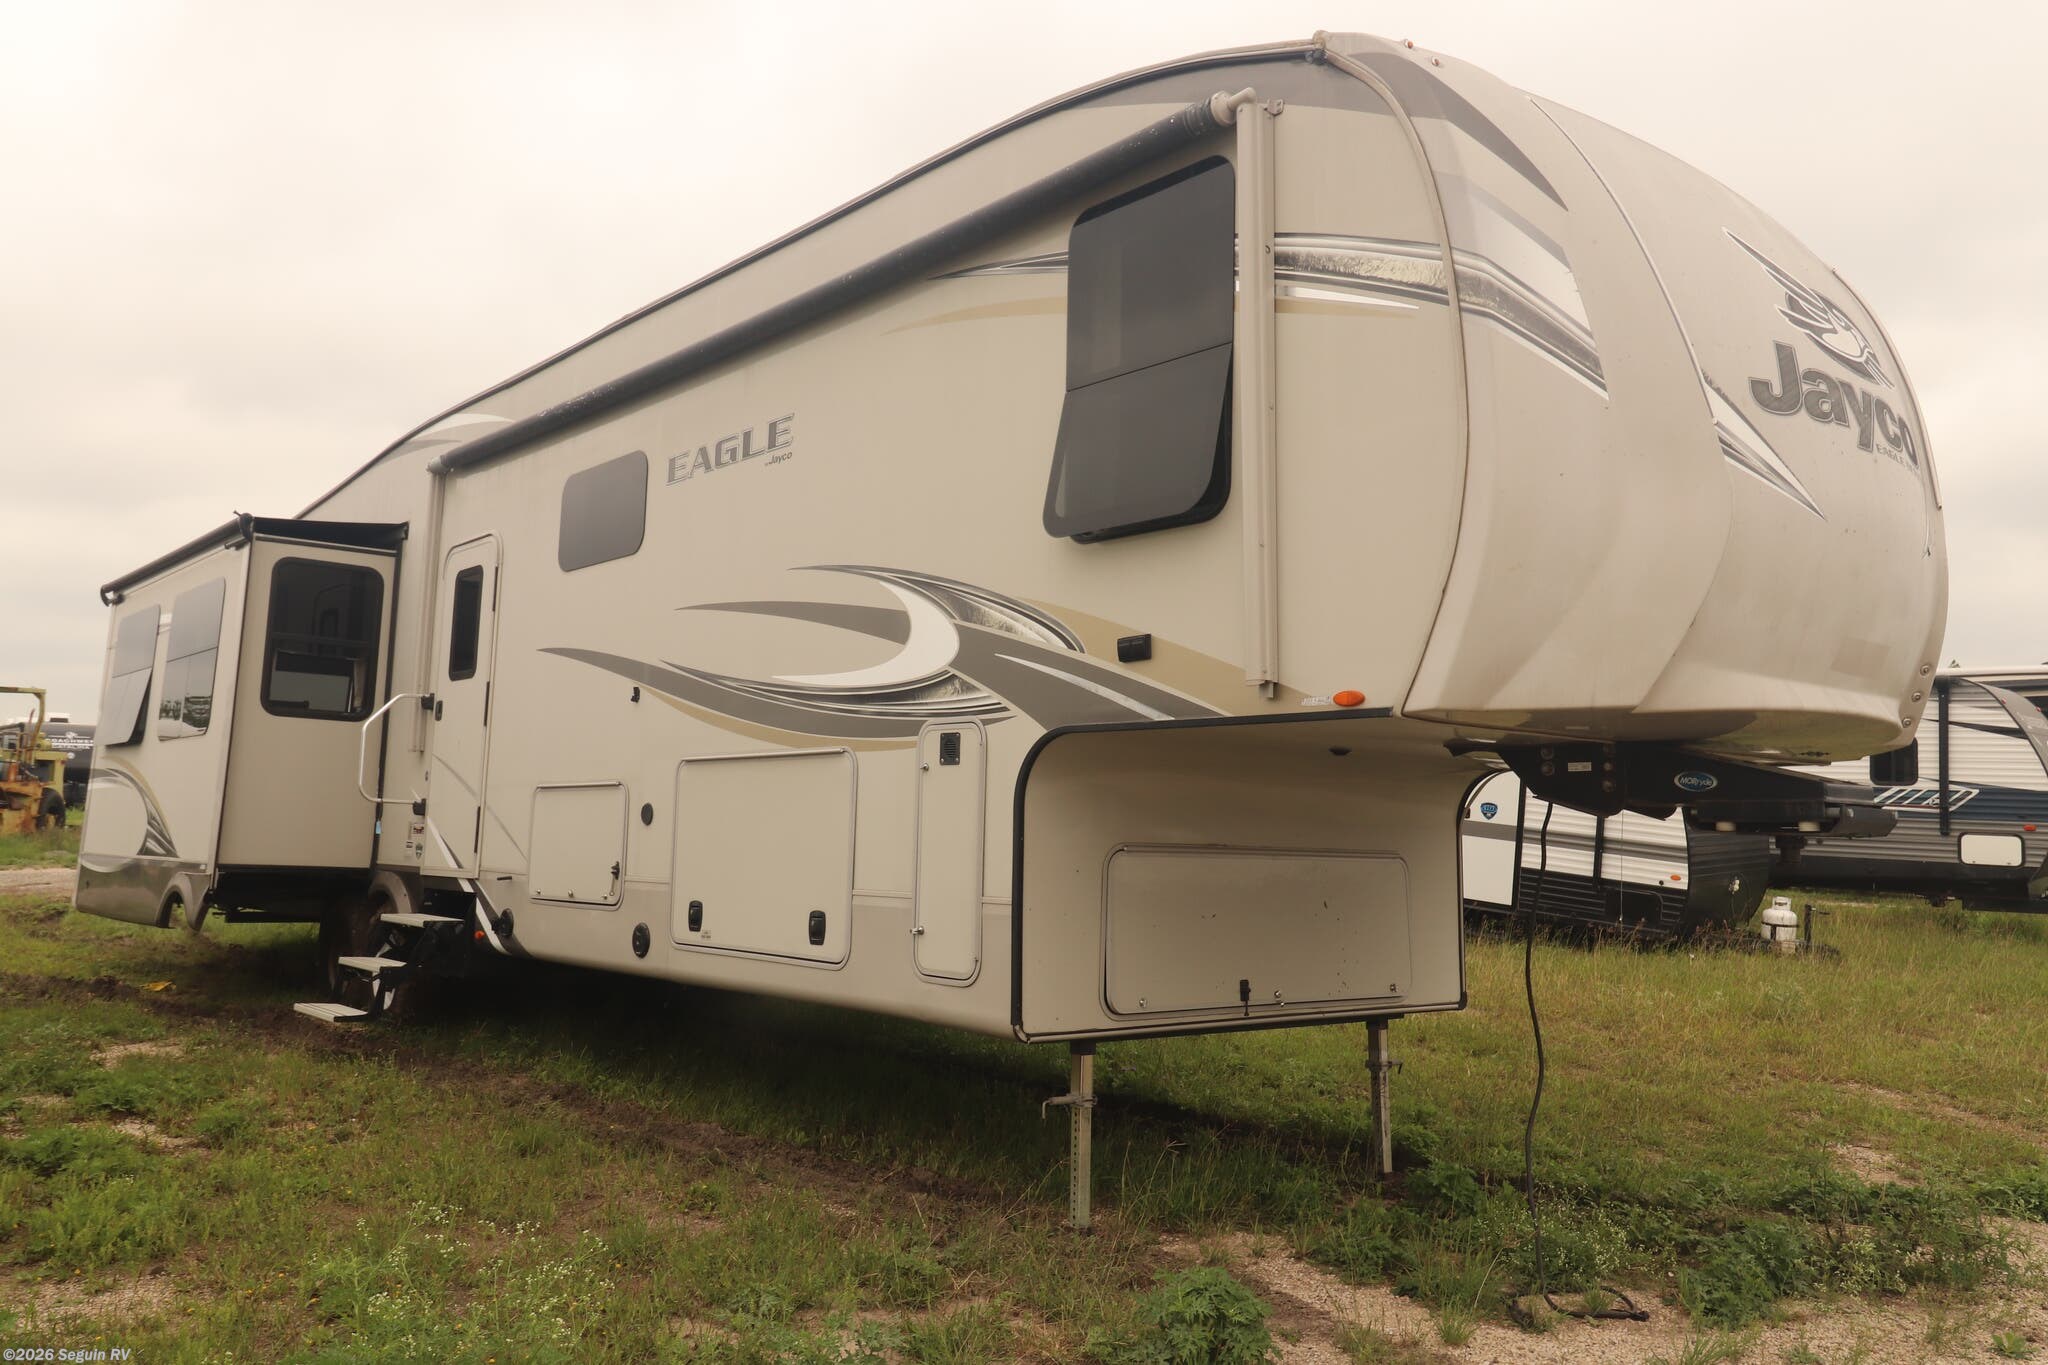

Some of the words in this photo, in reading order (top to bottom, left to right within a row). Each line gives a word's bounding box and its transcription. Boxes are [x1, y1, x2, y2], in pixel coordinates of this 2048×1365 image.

[1748, 340, 1920, 469] Jayco
[666, 412, 795, 487] EAGLE
[768, 452, 793, 465] Jayco
